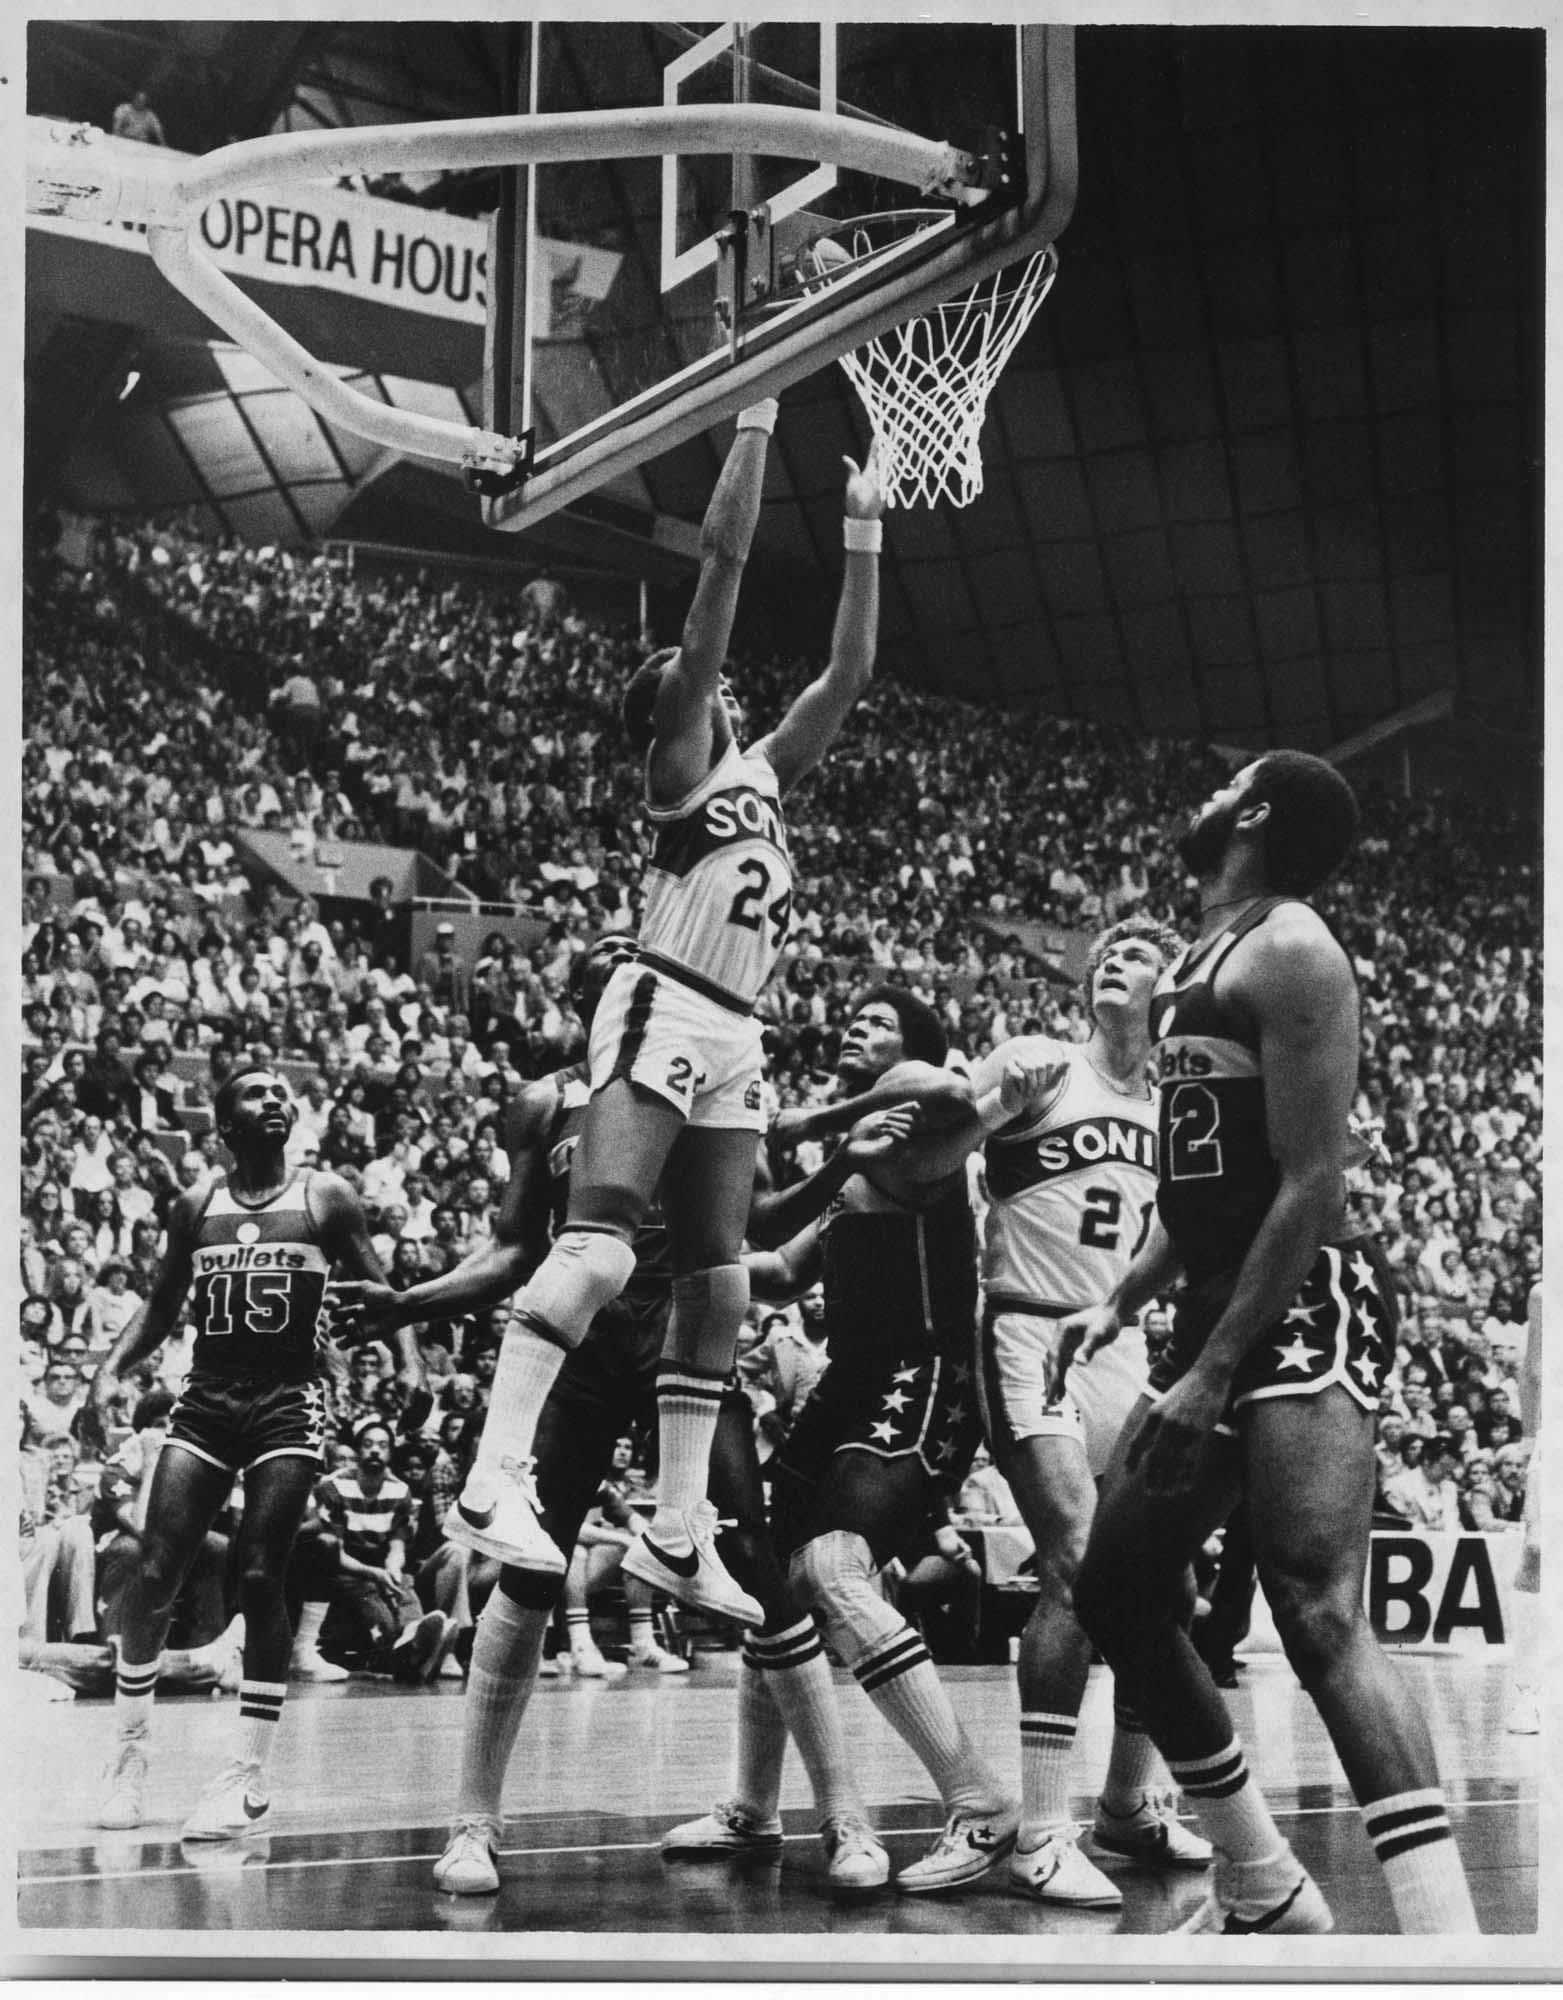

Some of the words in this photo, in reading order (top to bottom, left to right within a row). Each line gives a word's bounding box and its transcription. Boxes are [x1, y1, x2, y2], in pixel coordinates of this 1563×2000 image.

[200, 198, 357, 279] OPERA
[728, 858, 791, 949] 24
[1037, 1120, 1153, 1170] SONI
[200, 1246, 306, 1272] bullets
[205, 1271, 291, 1335] 15
[1369, 1537, 1505, 1644] BA
